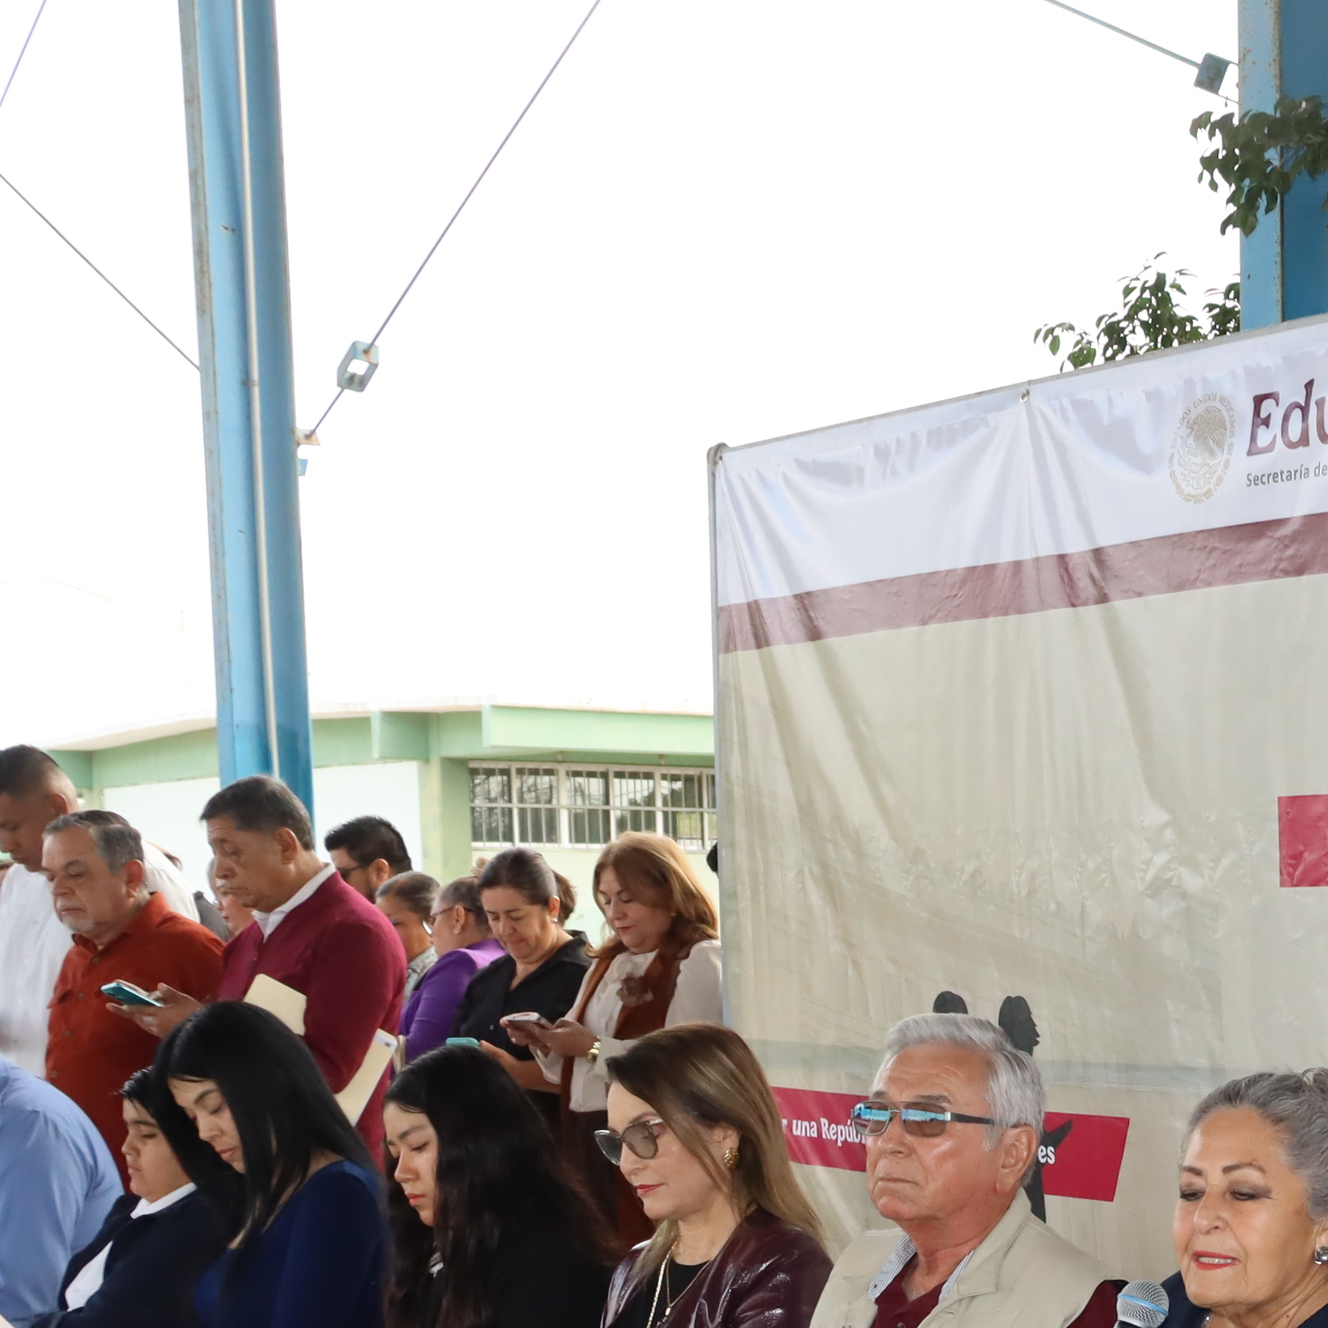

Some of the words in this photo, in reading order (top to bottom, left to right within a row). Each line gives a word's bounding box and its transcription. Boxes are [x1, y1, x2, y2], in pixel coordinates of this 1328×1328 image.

[1246, 464, 1310, 487] Secretaría
[1313, 460, 1328, 478] de
[792, 1119, 818, 1138] una
